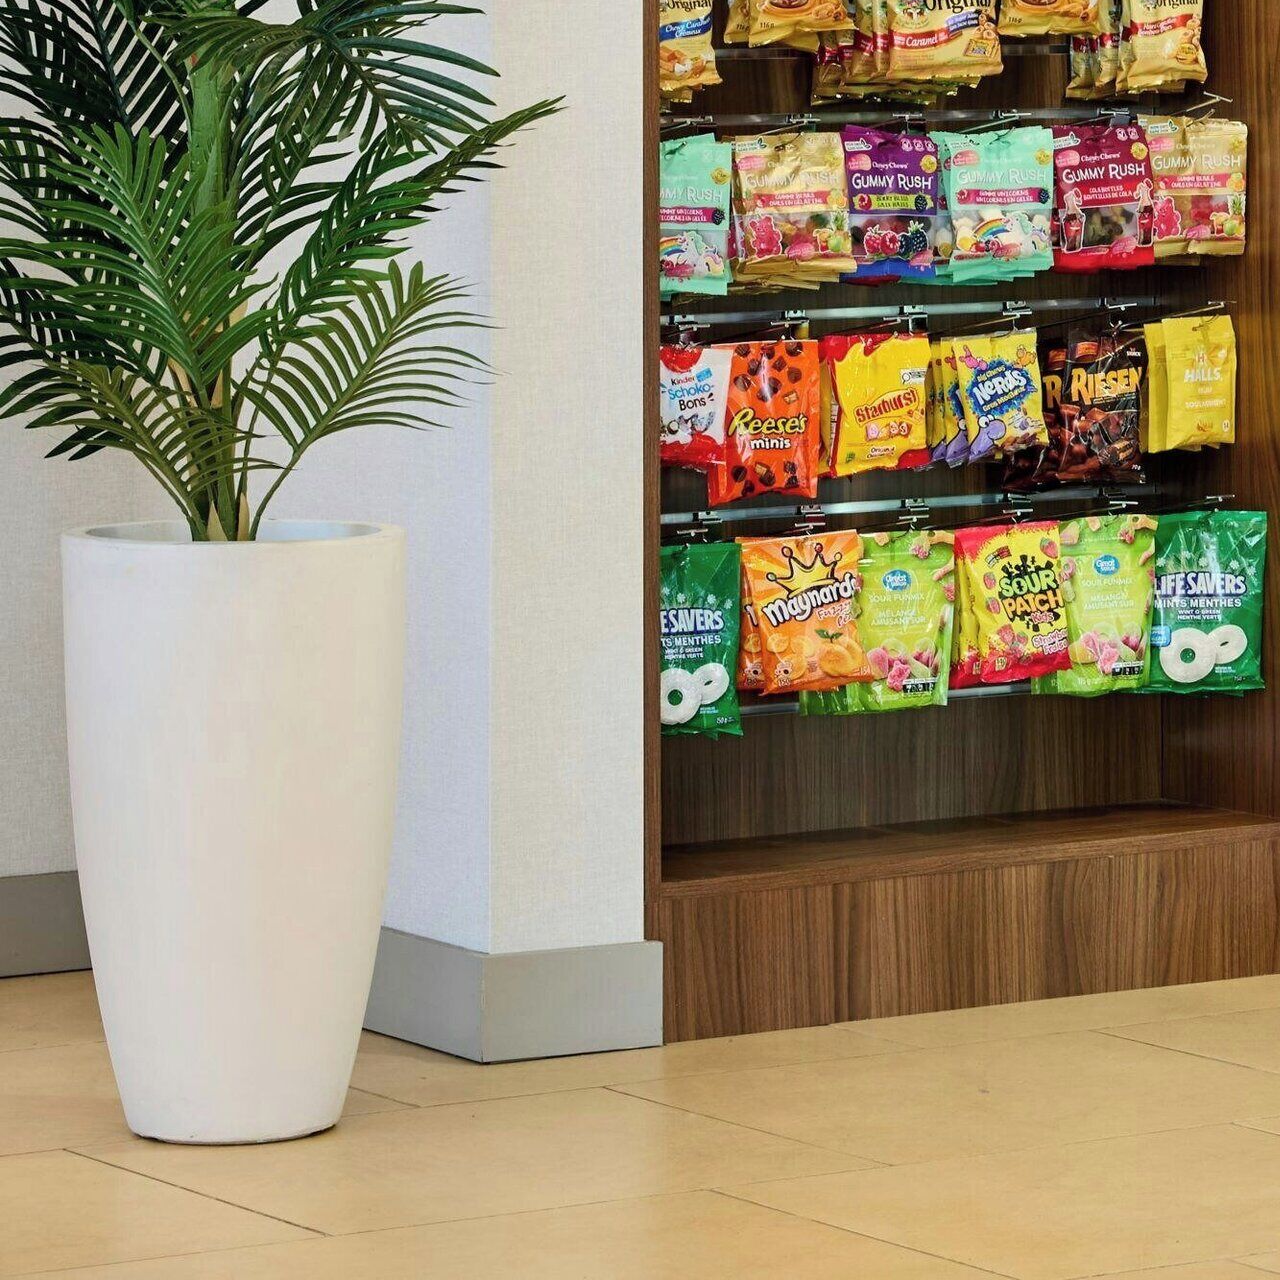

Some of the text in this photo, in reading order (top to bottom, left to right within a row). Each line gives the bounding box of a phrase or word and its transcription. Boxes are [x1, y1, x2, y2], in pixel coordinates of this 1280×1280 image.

[905, 34, 938, 48] Caramel
[1152, 154, 1241, 170] GUMMY RUSH
[852, 173, 931, 190] GUMMY RUSH
[1062, 163, 1145, 184] GUMMY RUSH
[687, 185, 722, 204] RUSH
[671, 376, 696, 385] Kinder
[1184, 367, 1221, 383] HALLS
[1070, 366, 1143, 405] RIESEN
[679, 397, 707, 411] Bons
[855, 389, 919, 424] Starburst
[727, 407, 807, 436] Reese's
[750, 437, 791, 450] minis
[1000, 570, 1058, 596] SOUR
[1188, 574, 1247, 595] SAVERS
[1002, 589, 1064, 618] PATCH
[1190, 598, 1242, 608] MENTHES
[669, 609, 724, 632] SAVERS
[1031, 612, 1054, 623] Kids
[673, 636, 721, 646] MENTHES
